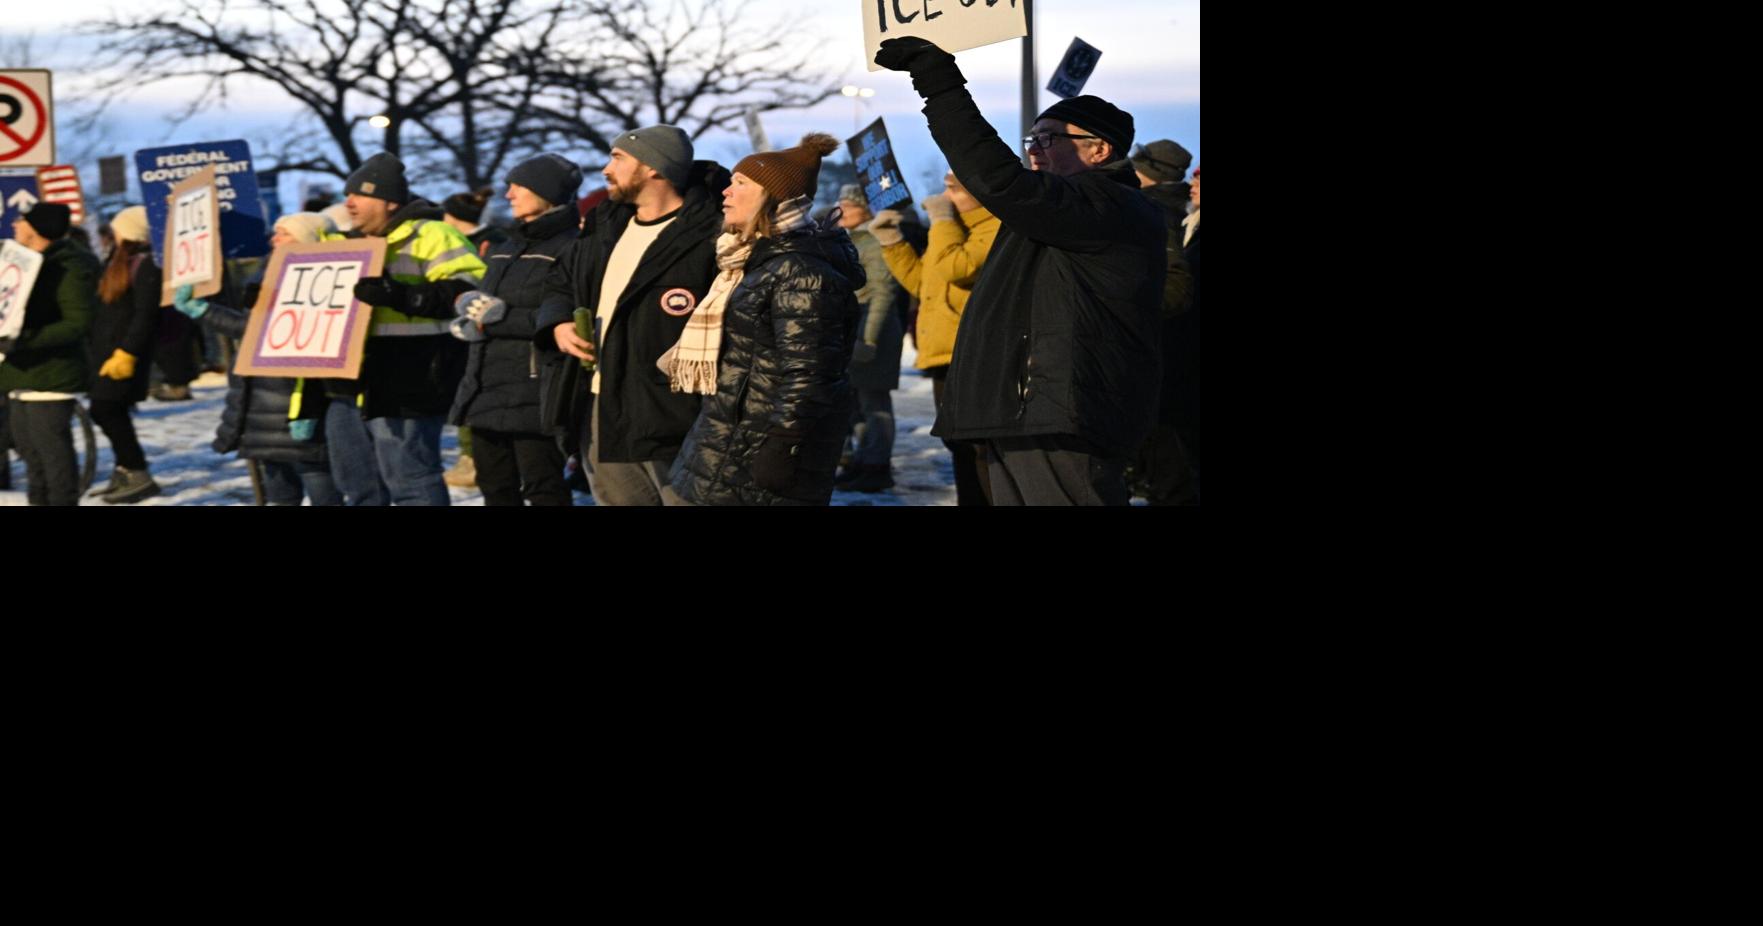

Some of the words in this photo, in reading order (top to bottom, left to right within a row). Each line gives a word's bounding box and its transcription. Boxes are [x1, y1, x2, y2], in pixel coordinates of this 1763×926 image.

[178, 193, 207, 236] ICE
[175, 232, 209, 276] OUT
[281, 265, 356, 309] ICE
[268, 309, 345, 353] OUT
